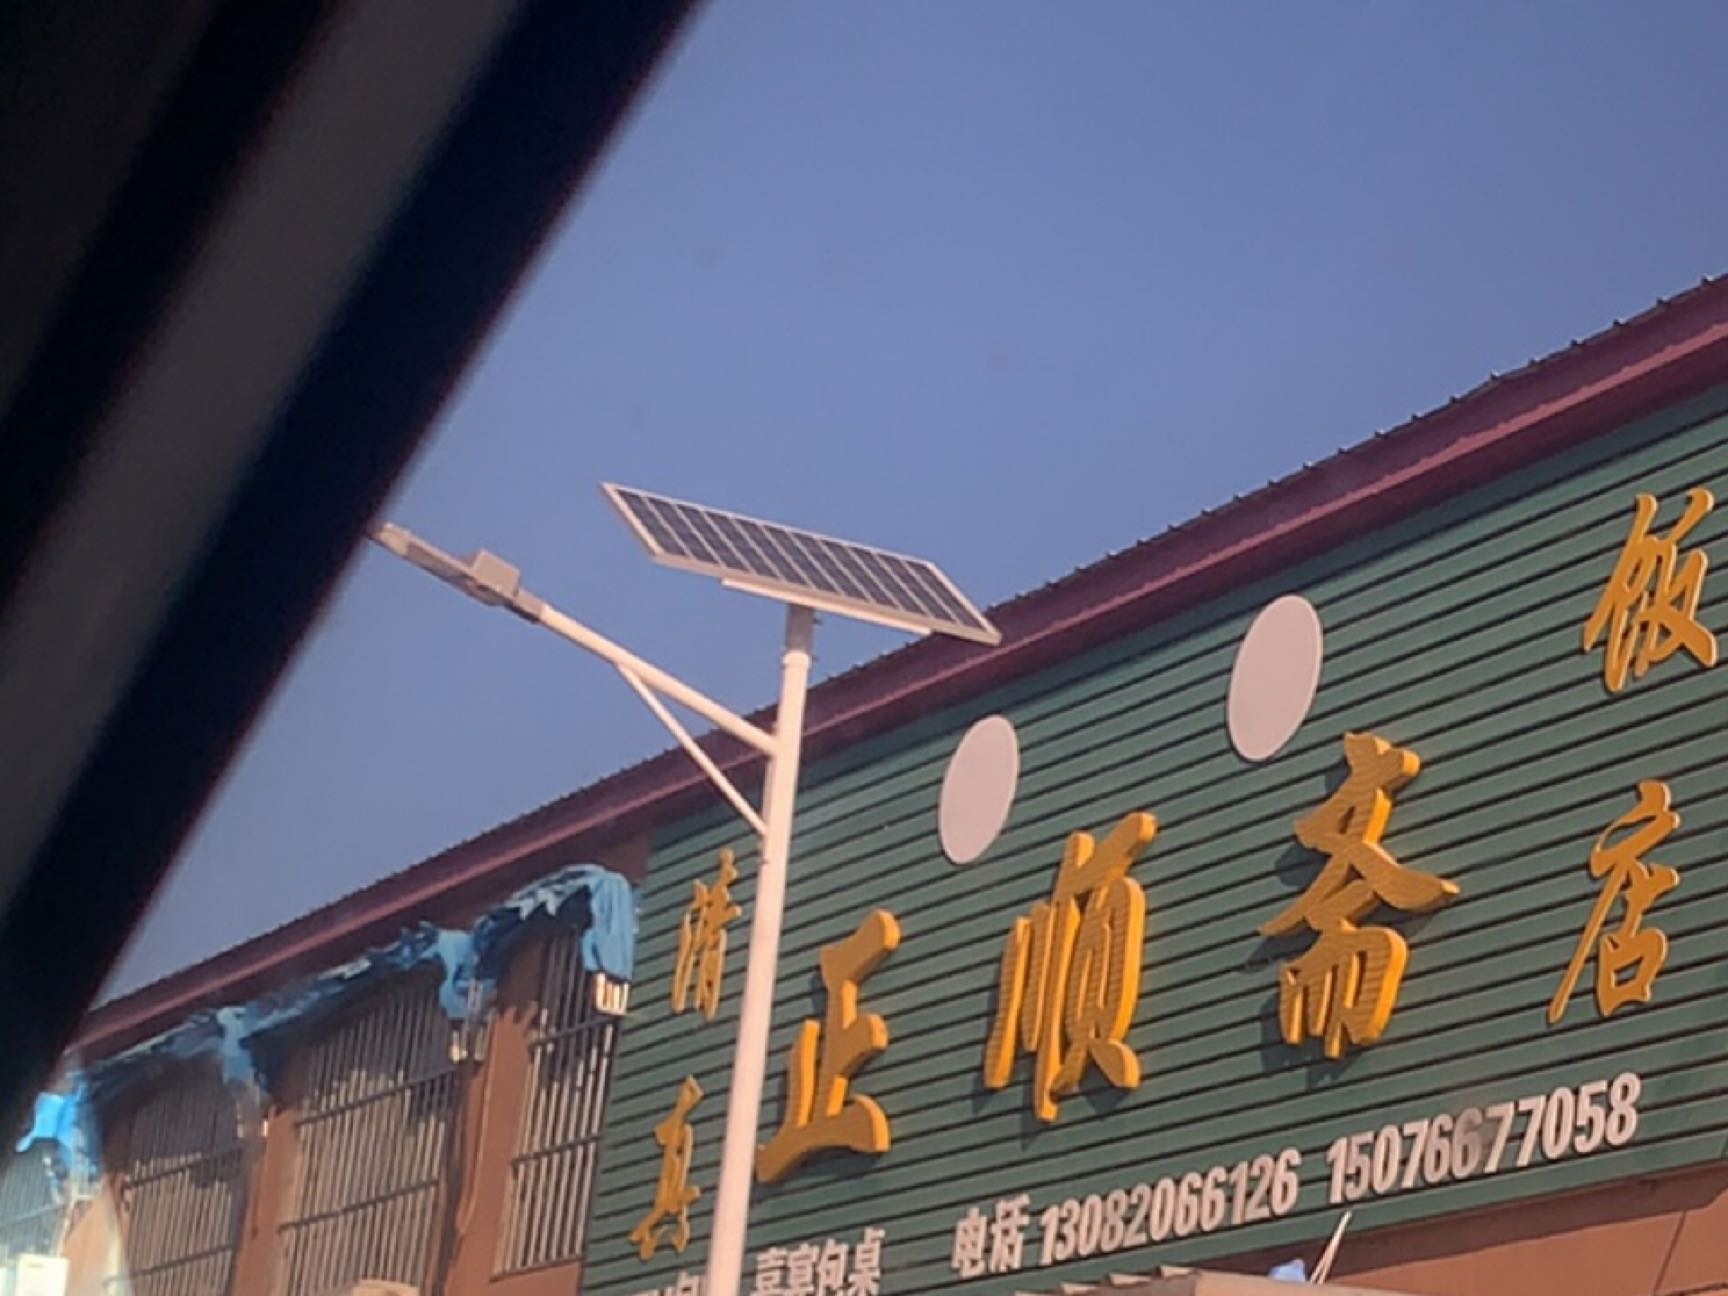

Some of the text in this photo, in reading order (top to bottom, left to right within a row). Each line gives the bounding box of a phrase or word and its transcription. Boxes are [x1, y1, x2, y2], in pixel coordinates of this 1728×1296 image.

[755, 732, 1461, 1183] 正顺斋
[1547, 487, 1719, 1026] 饭店
[630, 848, 742, 1260] 清真
[950, 1192, 1031, 1280] 电话
[1039, 1146, 1302, 1266] 13082066126
[1326, 1072, 1642, 1204] 15076677058
